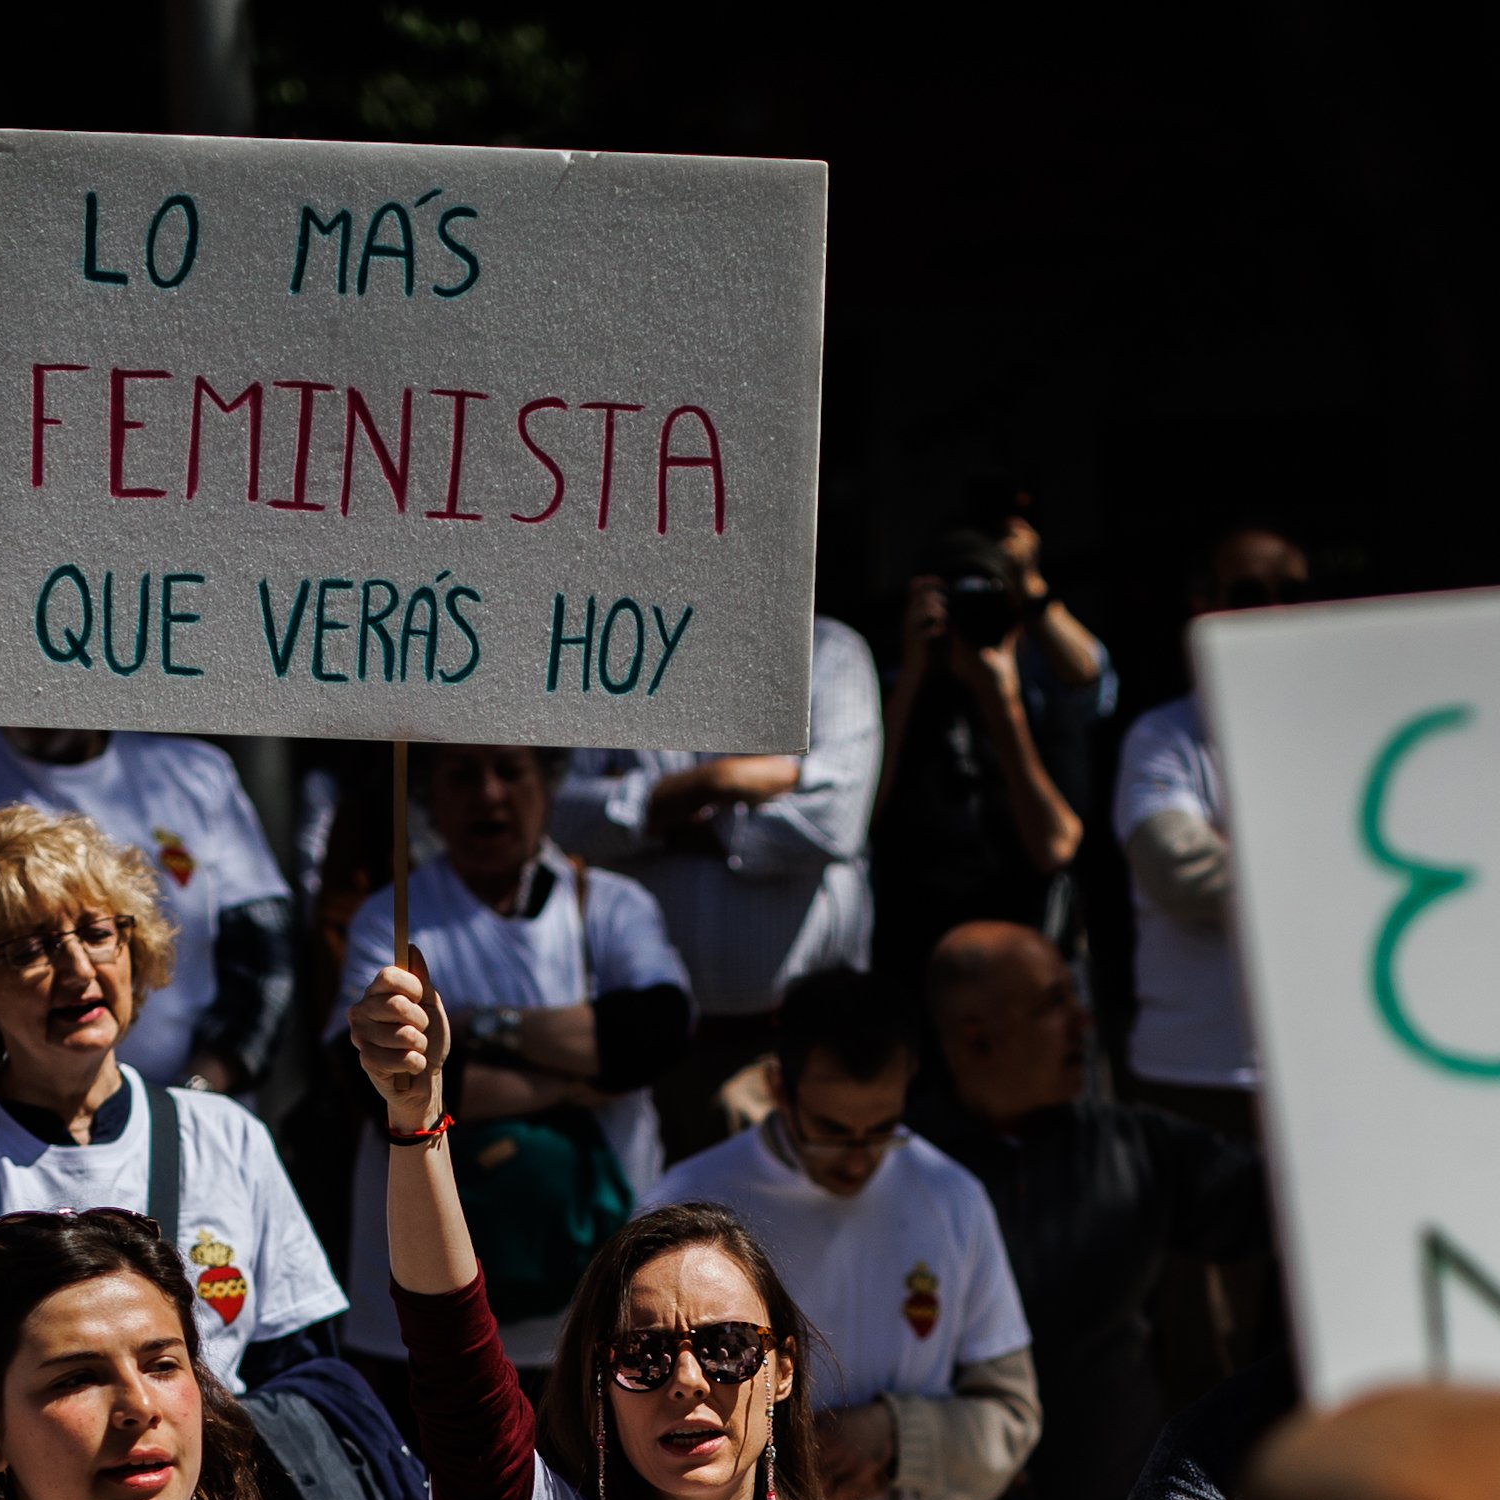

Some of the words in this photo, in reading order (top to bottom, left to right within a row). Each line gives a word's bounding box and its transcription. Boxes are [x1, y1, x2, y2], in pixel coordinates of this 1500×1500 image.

[80, 191, 200, 290] LO
[287, 188, 482, 299] MÁS
[29, 362, 727, 536] FEMINISTA
[34, 563, 205, 678] QUE
[258, 570, 483, 686] VERÁS
[544, 592, 695, 696] HOY
